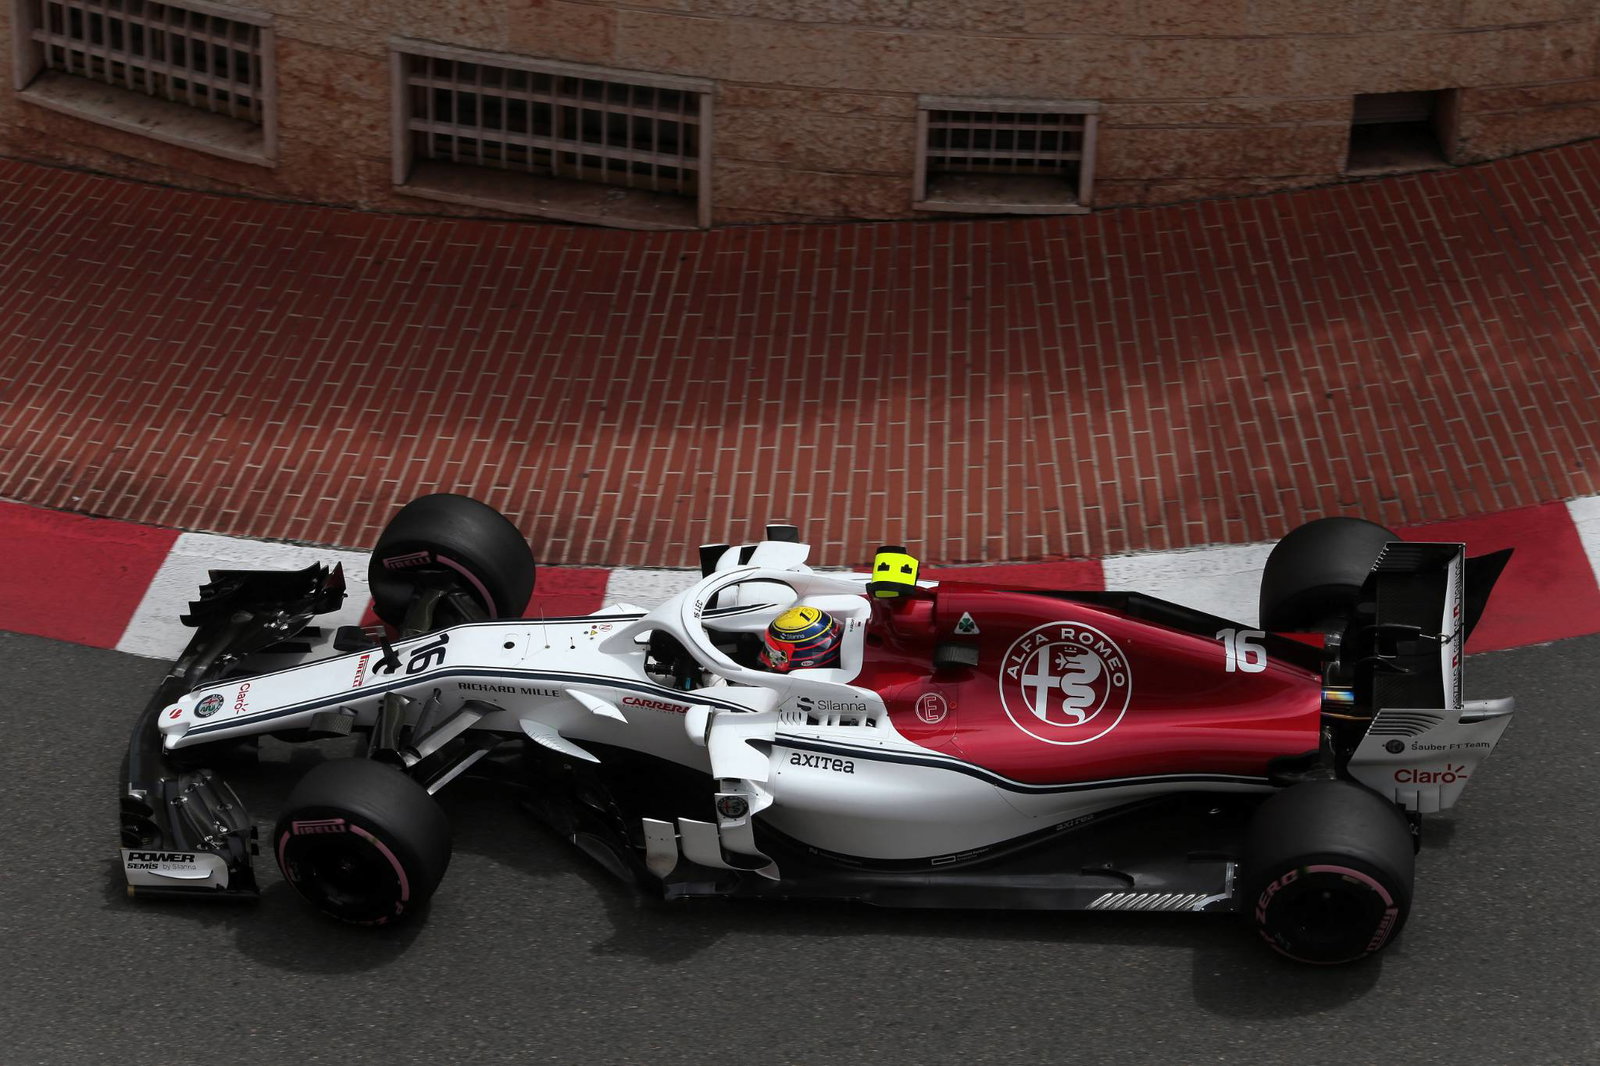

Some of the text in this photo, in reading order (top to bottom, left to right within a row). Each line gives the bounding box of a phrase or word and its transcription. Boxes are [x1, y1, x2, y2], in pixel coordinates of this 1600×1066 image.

[382, 551, 431, 568] PIRELLI
[406, 632, 449, 674] 16
[1006, 627, 1125, 687] ALFA ROMEO
[1215, 628, 1267, 673] 16
[352, 654, 370, 687] PIRELLI
[234, 682, 251, 710] Claro
[458, 682, 560, 697] RICHARD MILLE
[817, 700, 867, 711] Silanna
[1411, 743, 1446, 751] Sauber
[1393, 768, 1457, 783] Claro
[292, 818, 346, 835] PIRELLI
[128, 852, 195, 862] POWER
[1255, 869, 1298, 924] ZERO
[1365, 907, 1399, 951] PIRELLI
